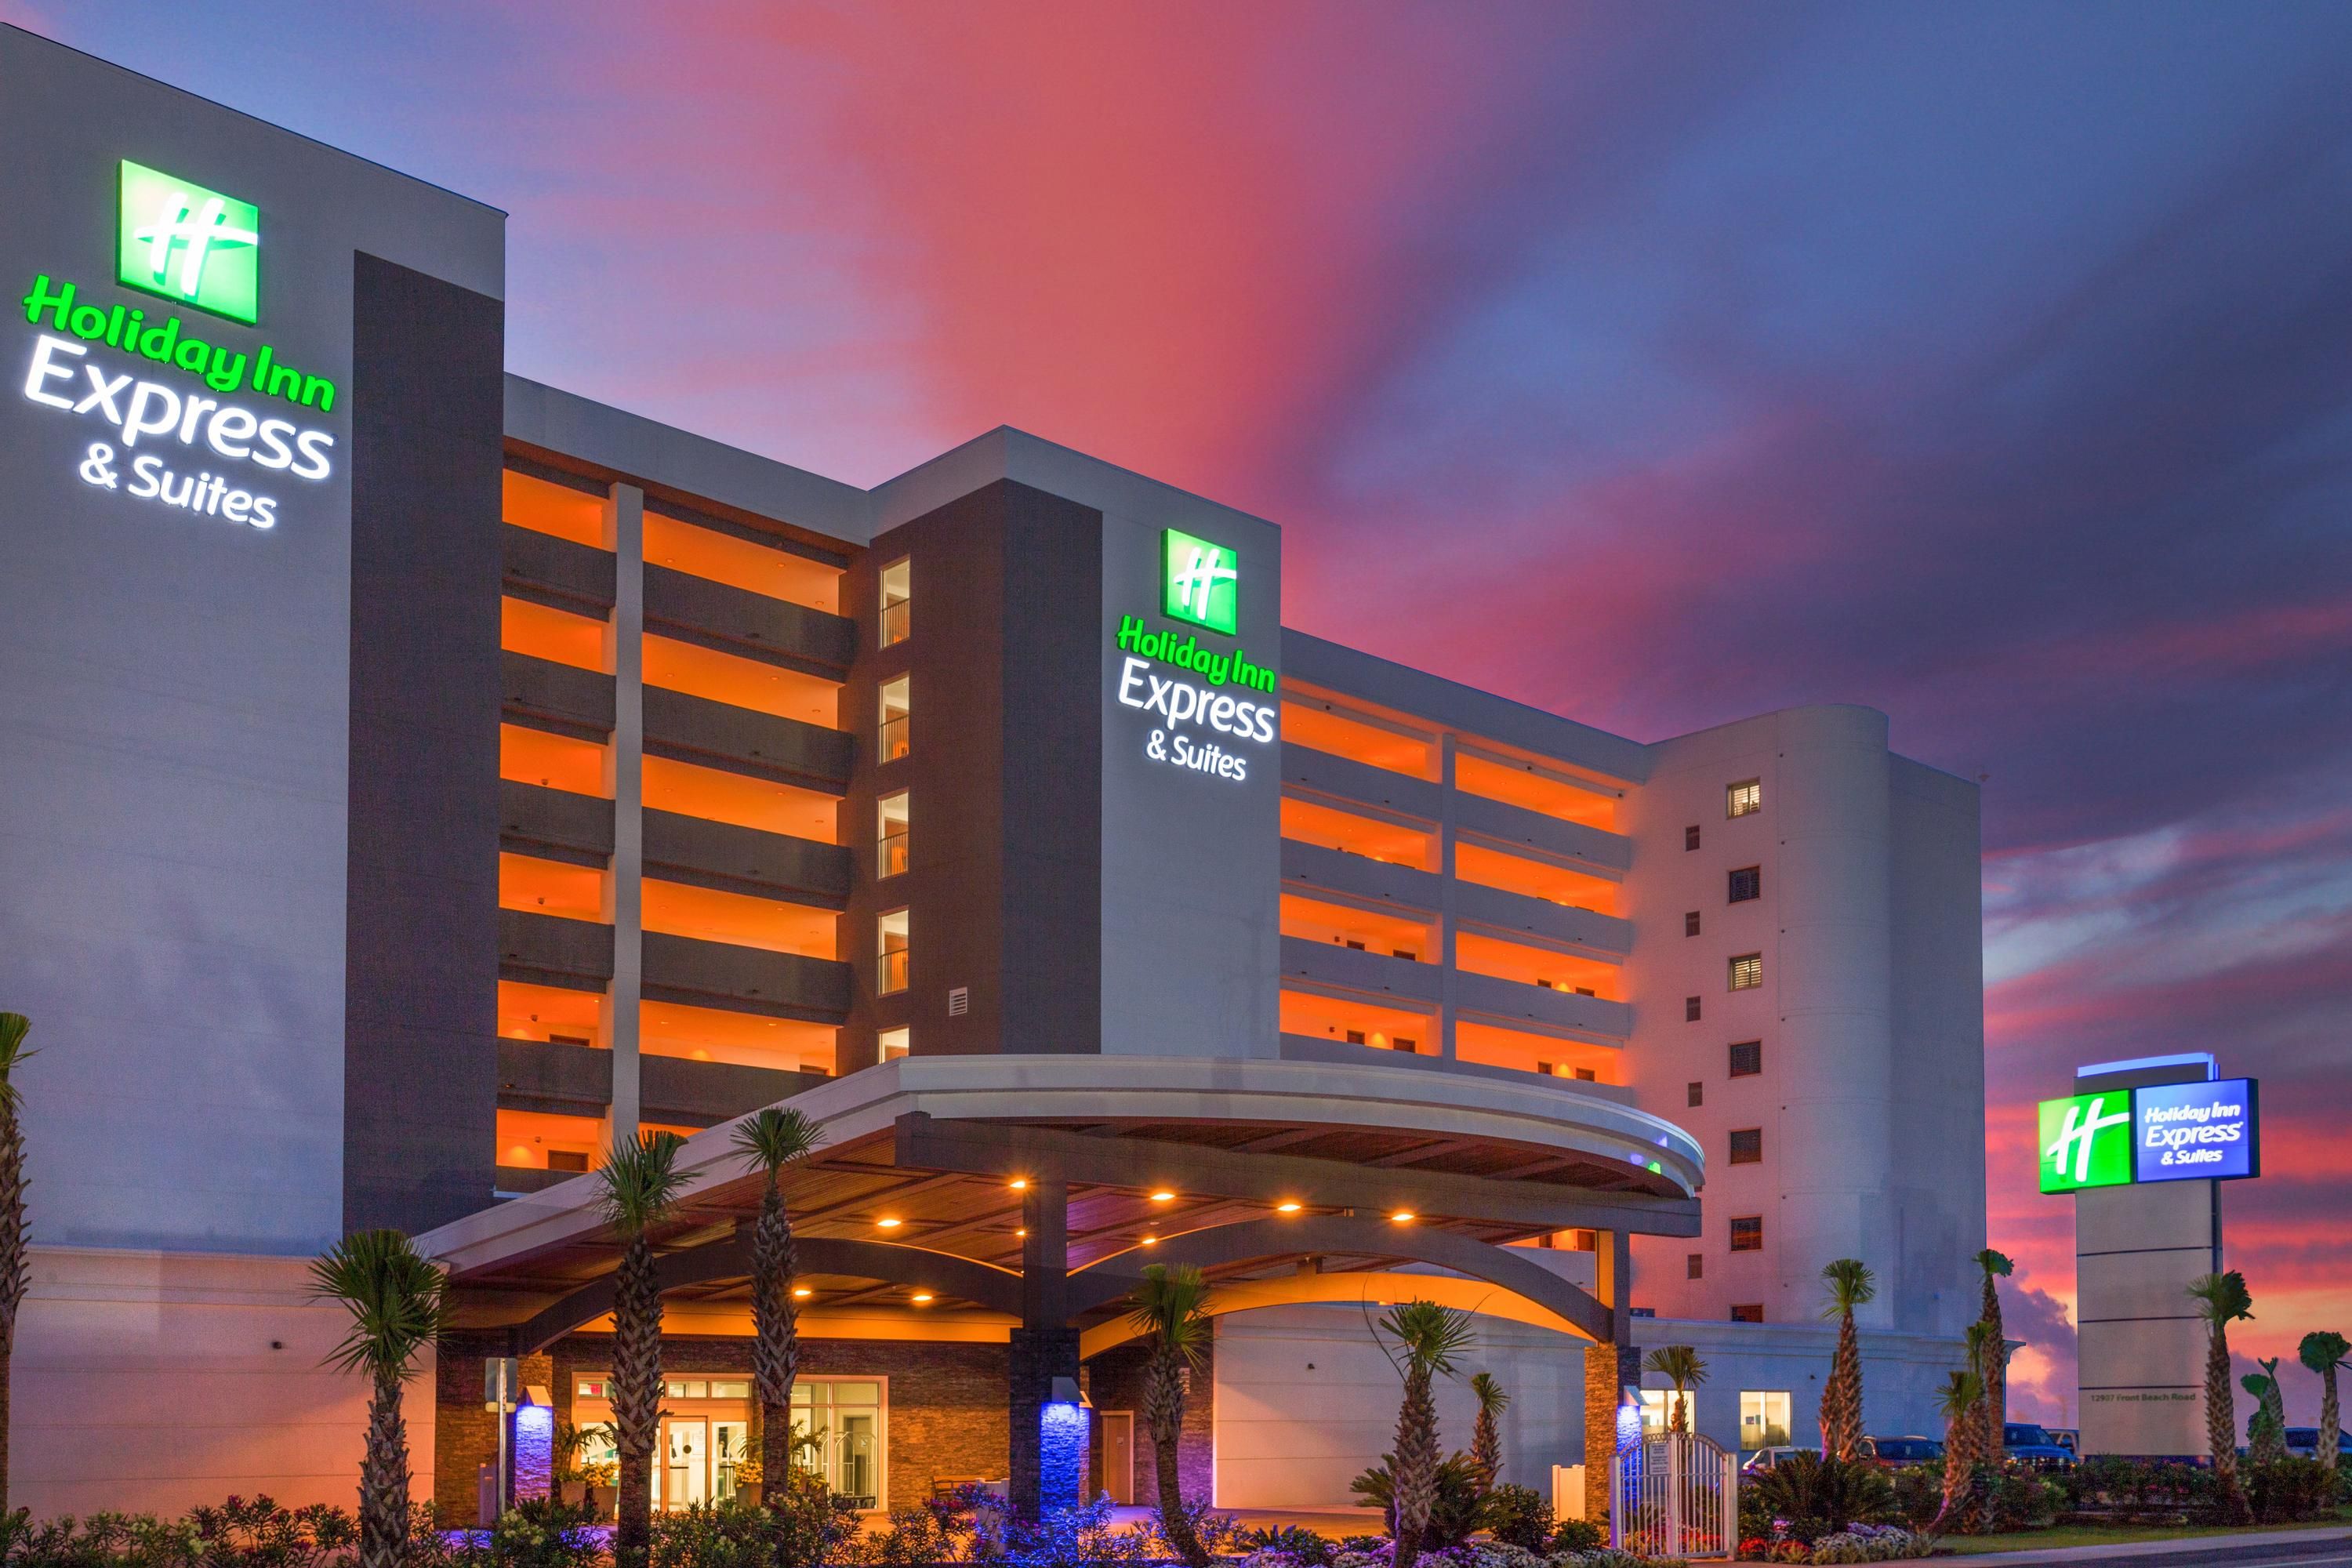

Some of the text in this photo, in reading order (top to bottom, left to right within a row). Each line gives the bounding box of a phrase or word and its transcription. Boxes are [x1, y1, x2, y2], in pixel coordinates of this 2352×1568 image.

[22, 274, 336, 412] Holiday Inn
[25, 335, 334, 480] Express
[80, 442, 277, 529] & Suites
[1117, 615, 1275, 692] Holiday Inn
[1118, 656, 1276, 743] Express
[1146, 729, 1247, 782] & Suites
[2144, 1102, 2241, 1123] Holiday Inn
[2145, 1123, 2241, 1150] Express
[2161, 1149, 2223, 1165] & Suites
